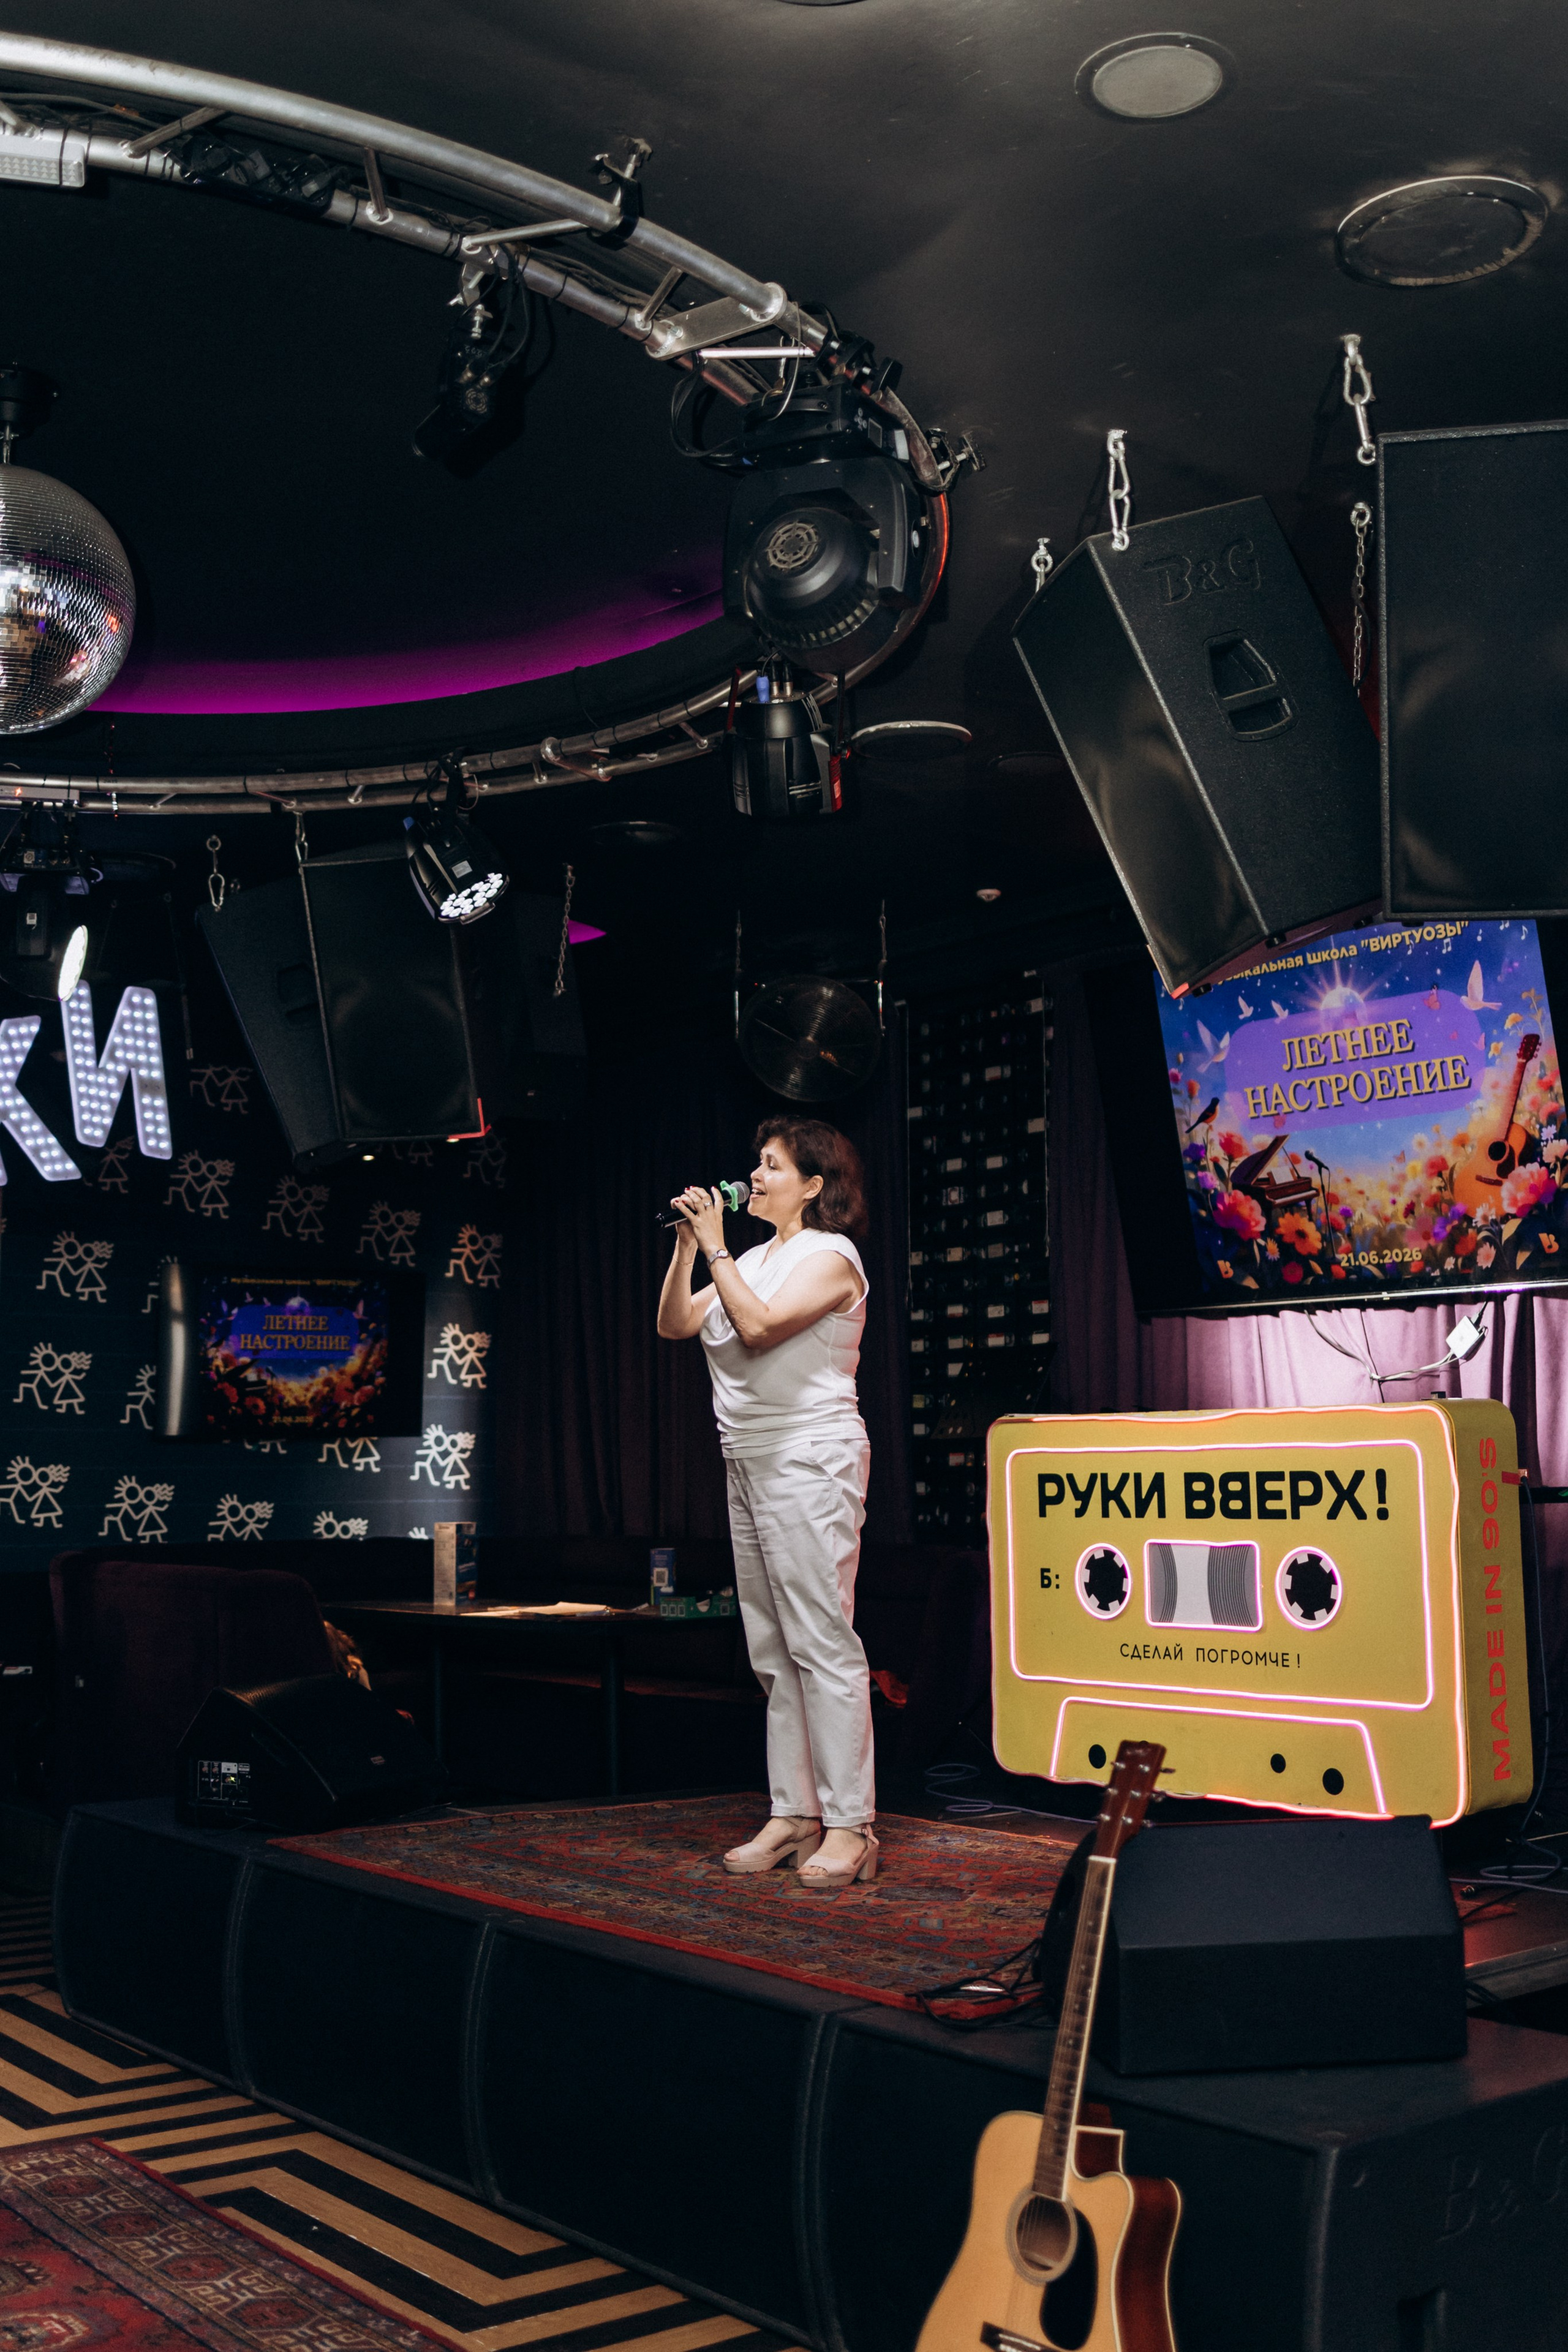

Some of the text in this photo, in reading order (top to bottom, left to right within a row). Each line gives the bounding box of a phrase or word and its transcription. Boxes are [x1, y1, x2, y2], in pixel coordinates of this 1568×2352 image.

[1142, 538, 1261, 606] B&G
[1306, 944, 1358, 965] школа
[1360, 921, 1469, 952] "ВИРТУОЗЫ"
[1281, 1019, 1414, 1072] ЛЕТНЕЕ
[1244, 1055, 1471, 1118] НАСТРОЕНИЕ
[1340, 1247, 1422, 1267] 21.06.2026
[239, 1333, 351, 1351] НАСТРОЕНИЕ
[262, 1314, 330, 1331] ЛЕТНЕЕ
[1037, 1472, 1167, 1519] РУКИ
[1039, 1567, 1061, 1589] Б:
[1479, 1438, 1512, 1781] MADE IN 90'S
[1120, 1643, 1183, 1661] СДЕЛАЙ
